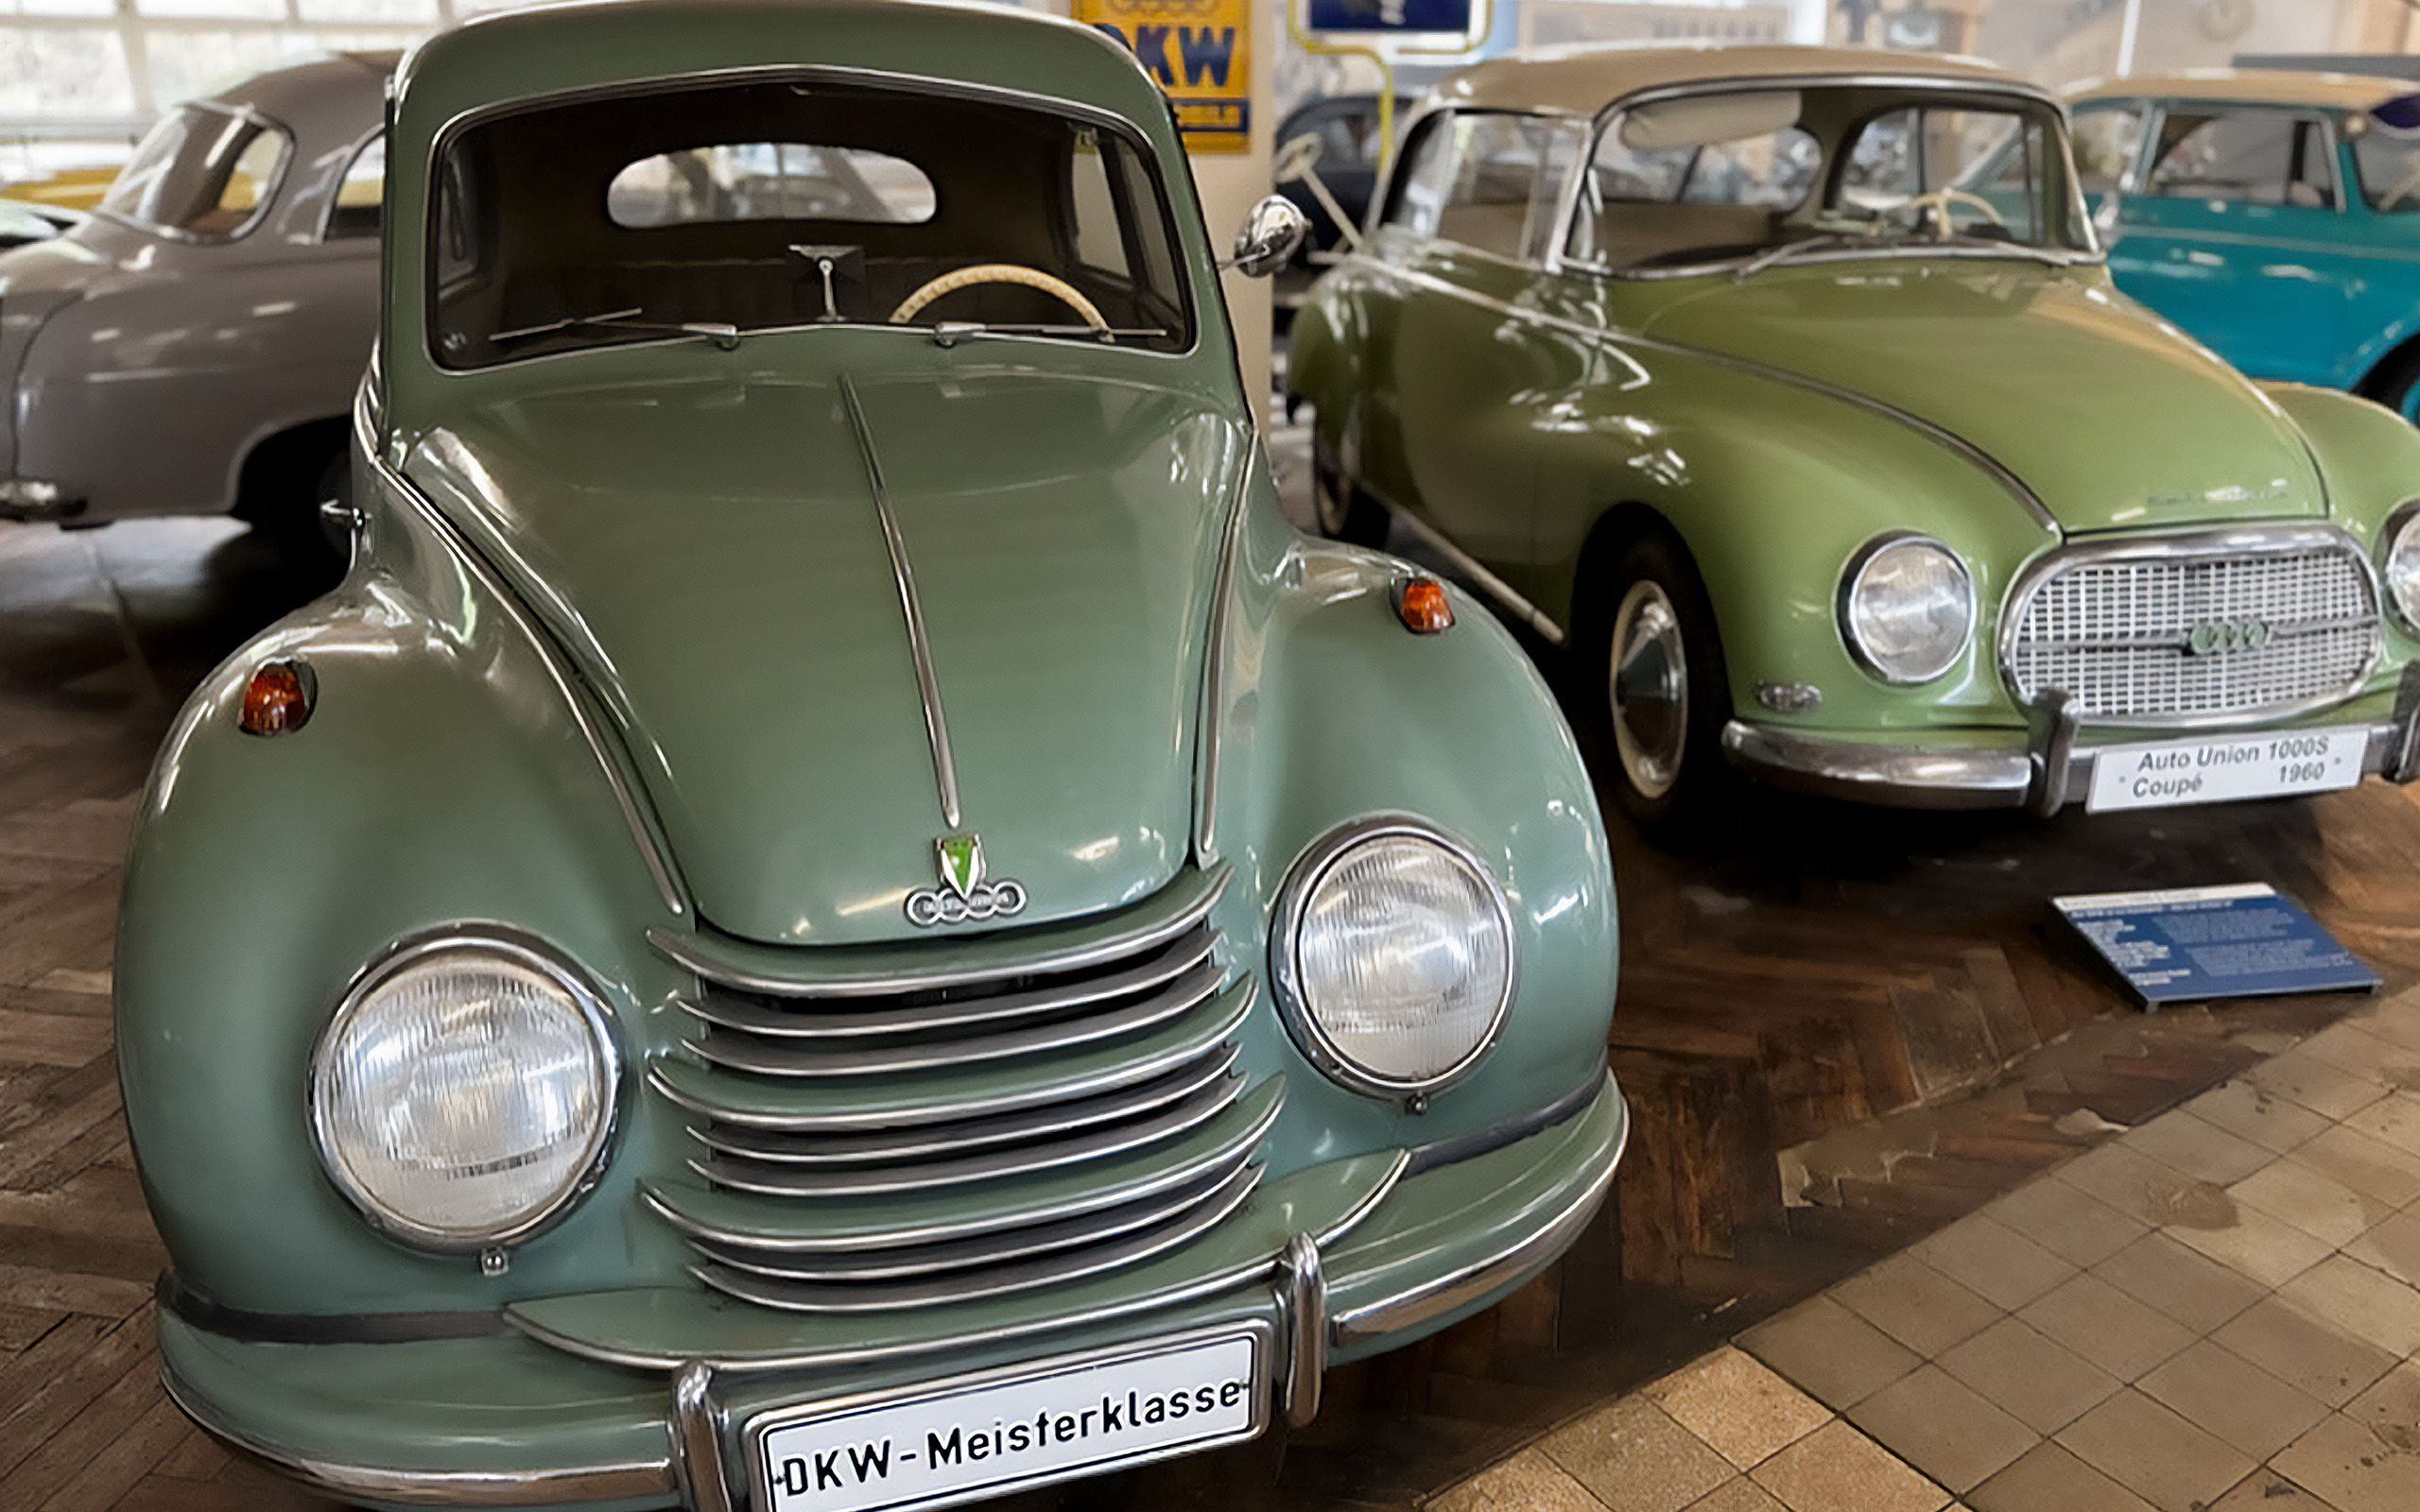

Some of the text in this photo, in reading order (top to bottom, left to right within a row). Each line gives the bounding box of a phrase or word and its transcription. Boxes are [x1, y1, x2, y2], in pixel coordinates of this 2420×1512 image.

[1093, 24, 1236, 87] KW
[2136, 735, 2330, 772] Auto Union 1000S
[2133, 762, 2325, 799] Coupé 1960
